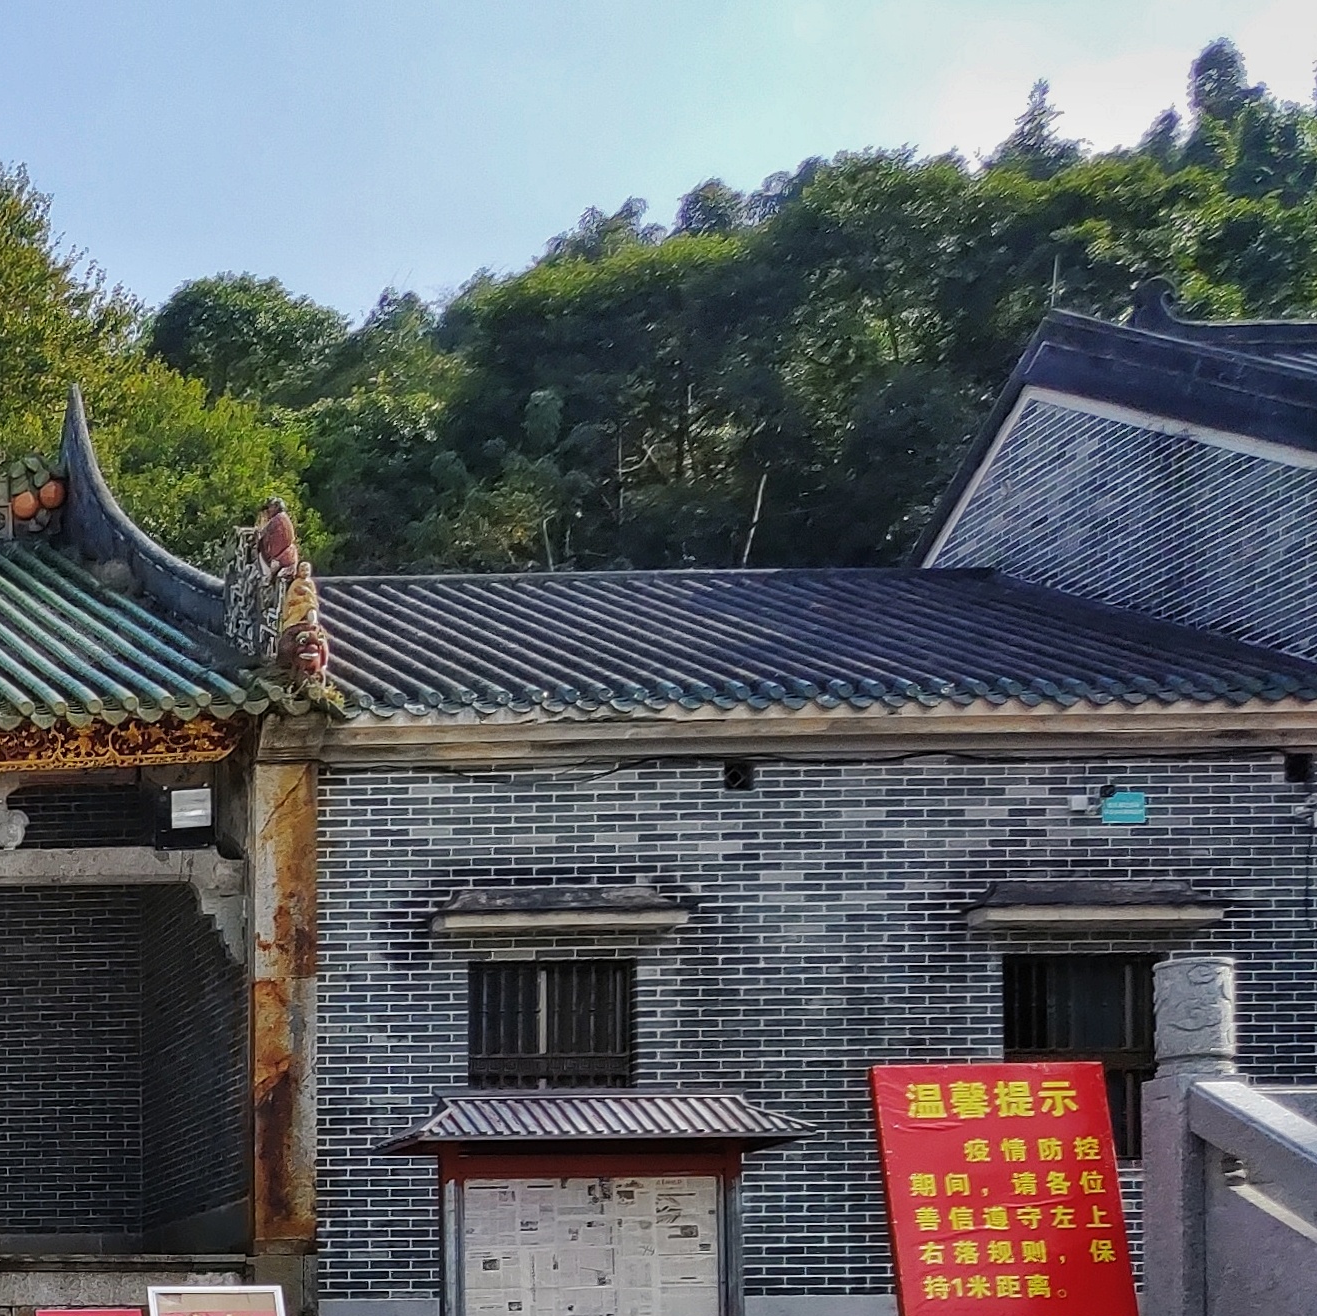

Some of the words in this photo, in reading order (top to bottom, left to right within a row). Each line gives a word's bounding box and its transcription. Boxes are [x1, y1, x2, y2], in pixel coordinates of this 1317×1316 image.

[905, 1080, 1080, 1119] 温馨提示
[964, 1137, 1102, 1163] 疫情防控
[908, 1170, 1107, 1197] 期间，请各位
[914, 1205, 1113, 1232] 善信遵守左上
[919, 1239, 1117, 1265] 右落规则，保
[923, 1274, 1068, 1300] 持1米距离。
